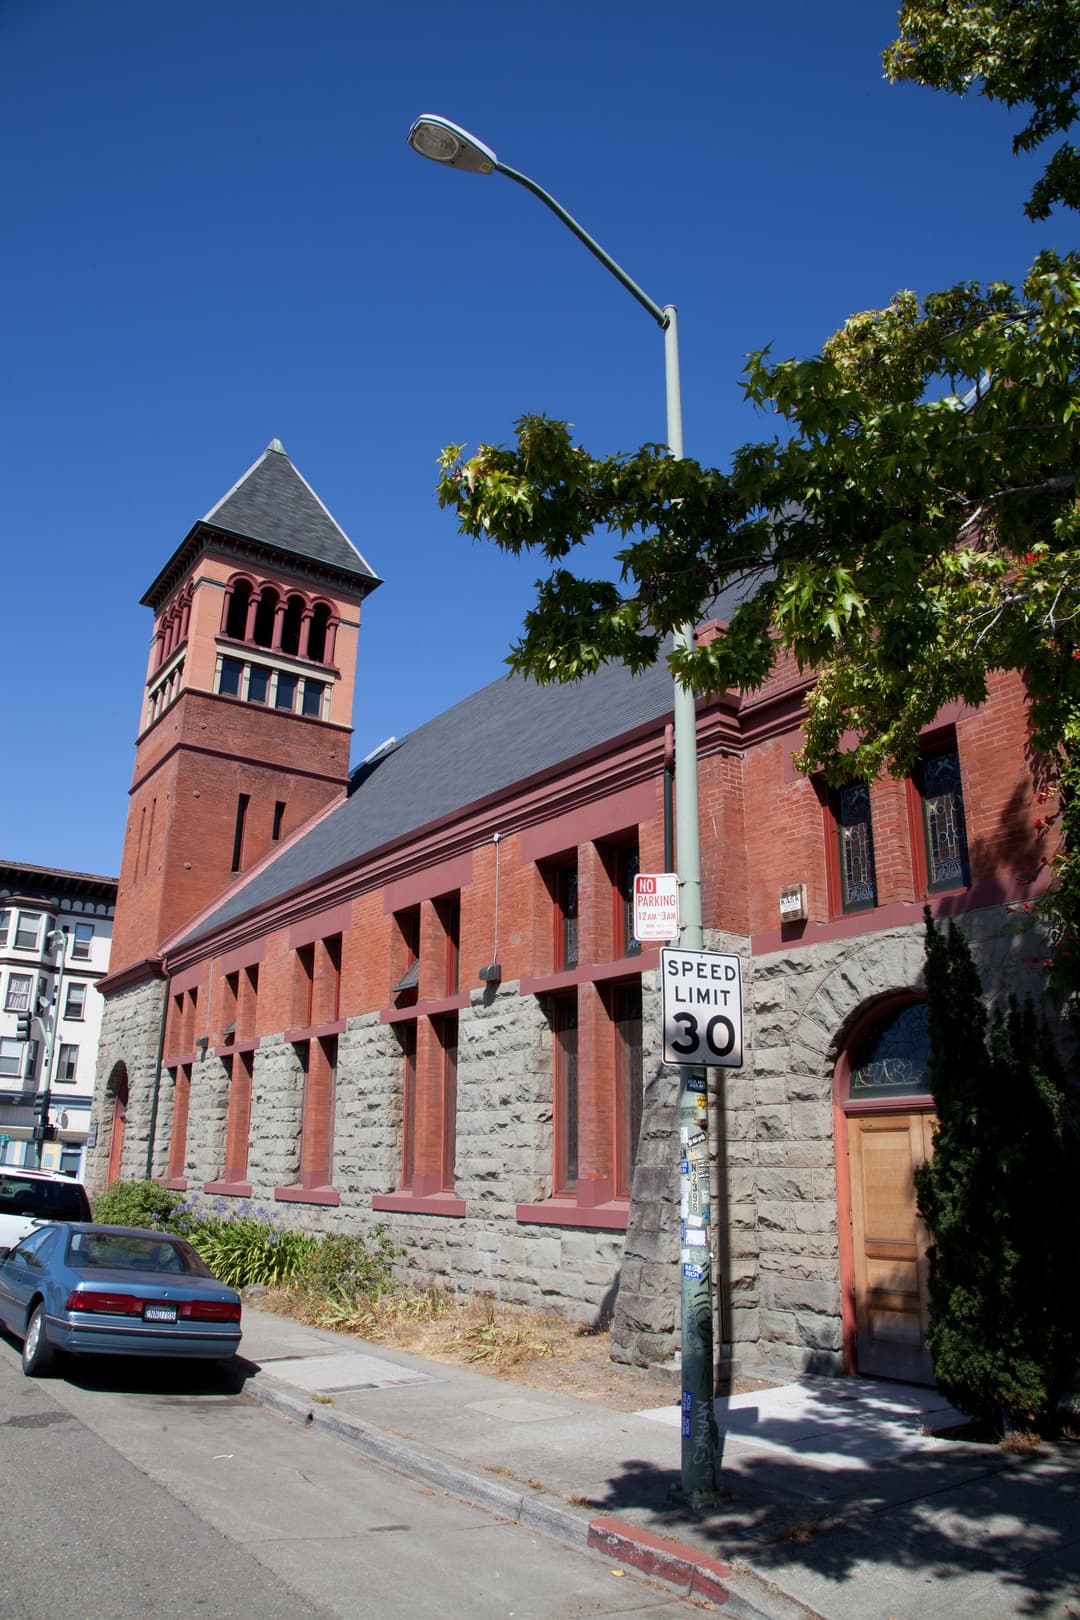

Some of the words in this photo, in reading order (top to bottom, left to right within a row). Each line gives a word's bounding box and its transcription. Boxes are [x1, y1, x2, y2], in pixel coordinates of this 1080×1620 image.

[639, 879, 654, 893] NO
[637, 895, 676, 907] PARKING
[668, 960, 736, 981] SPEED
[675, 985, 731, 1006] LIMIT
[671, 1012, 736, 1057] 30
